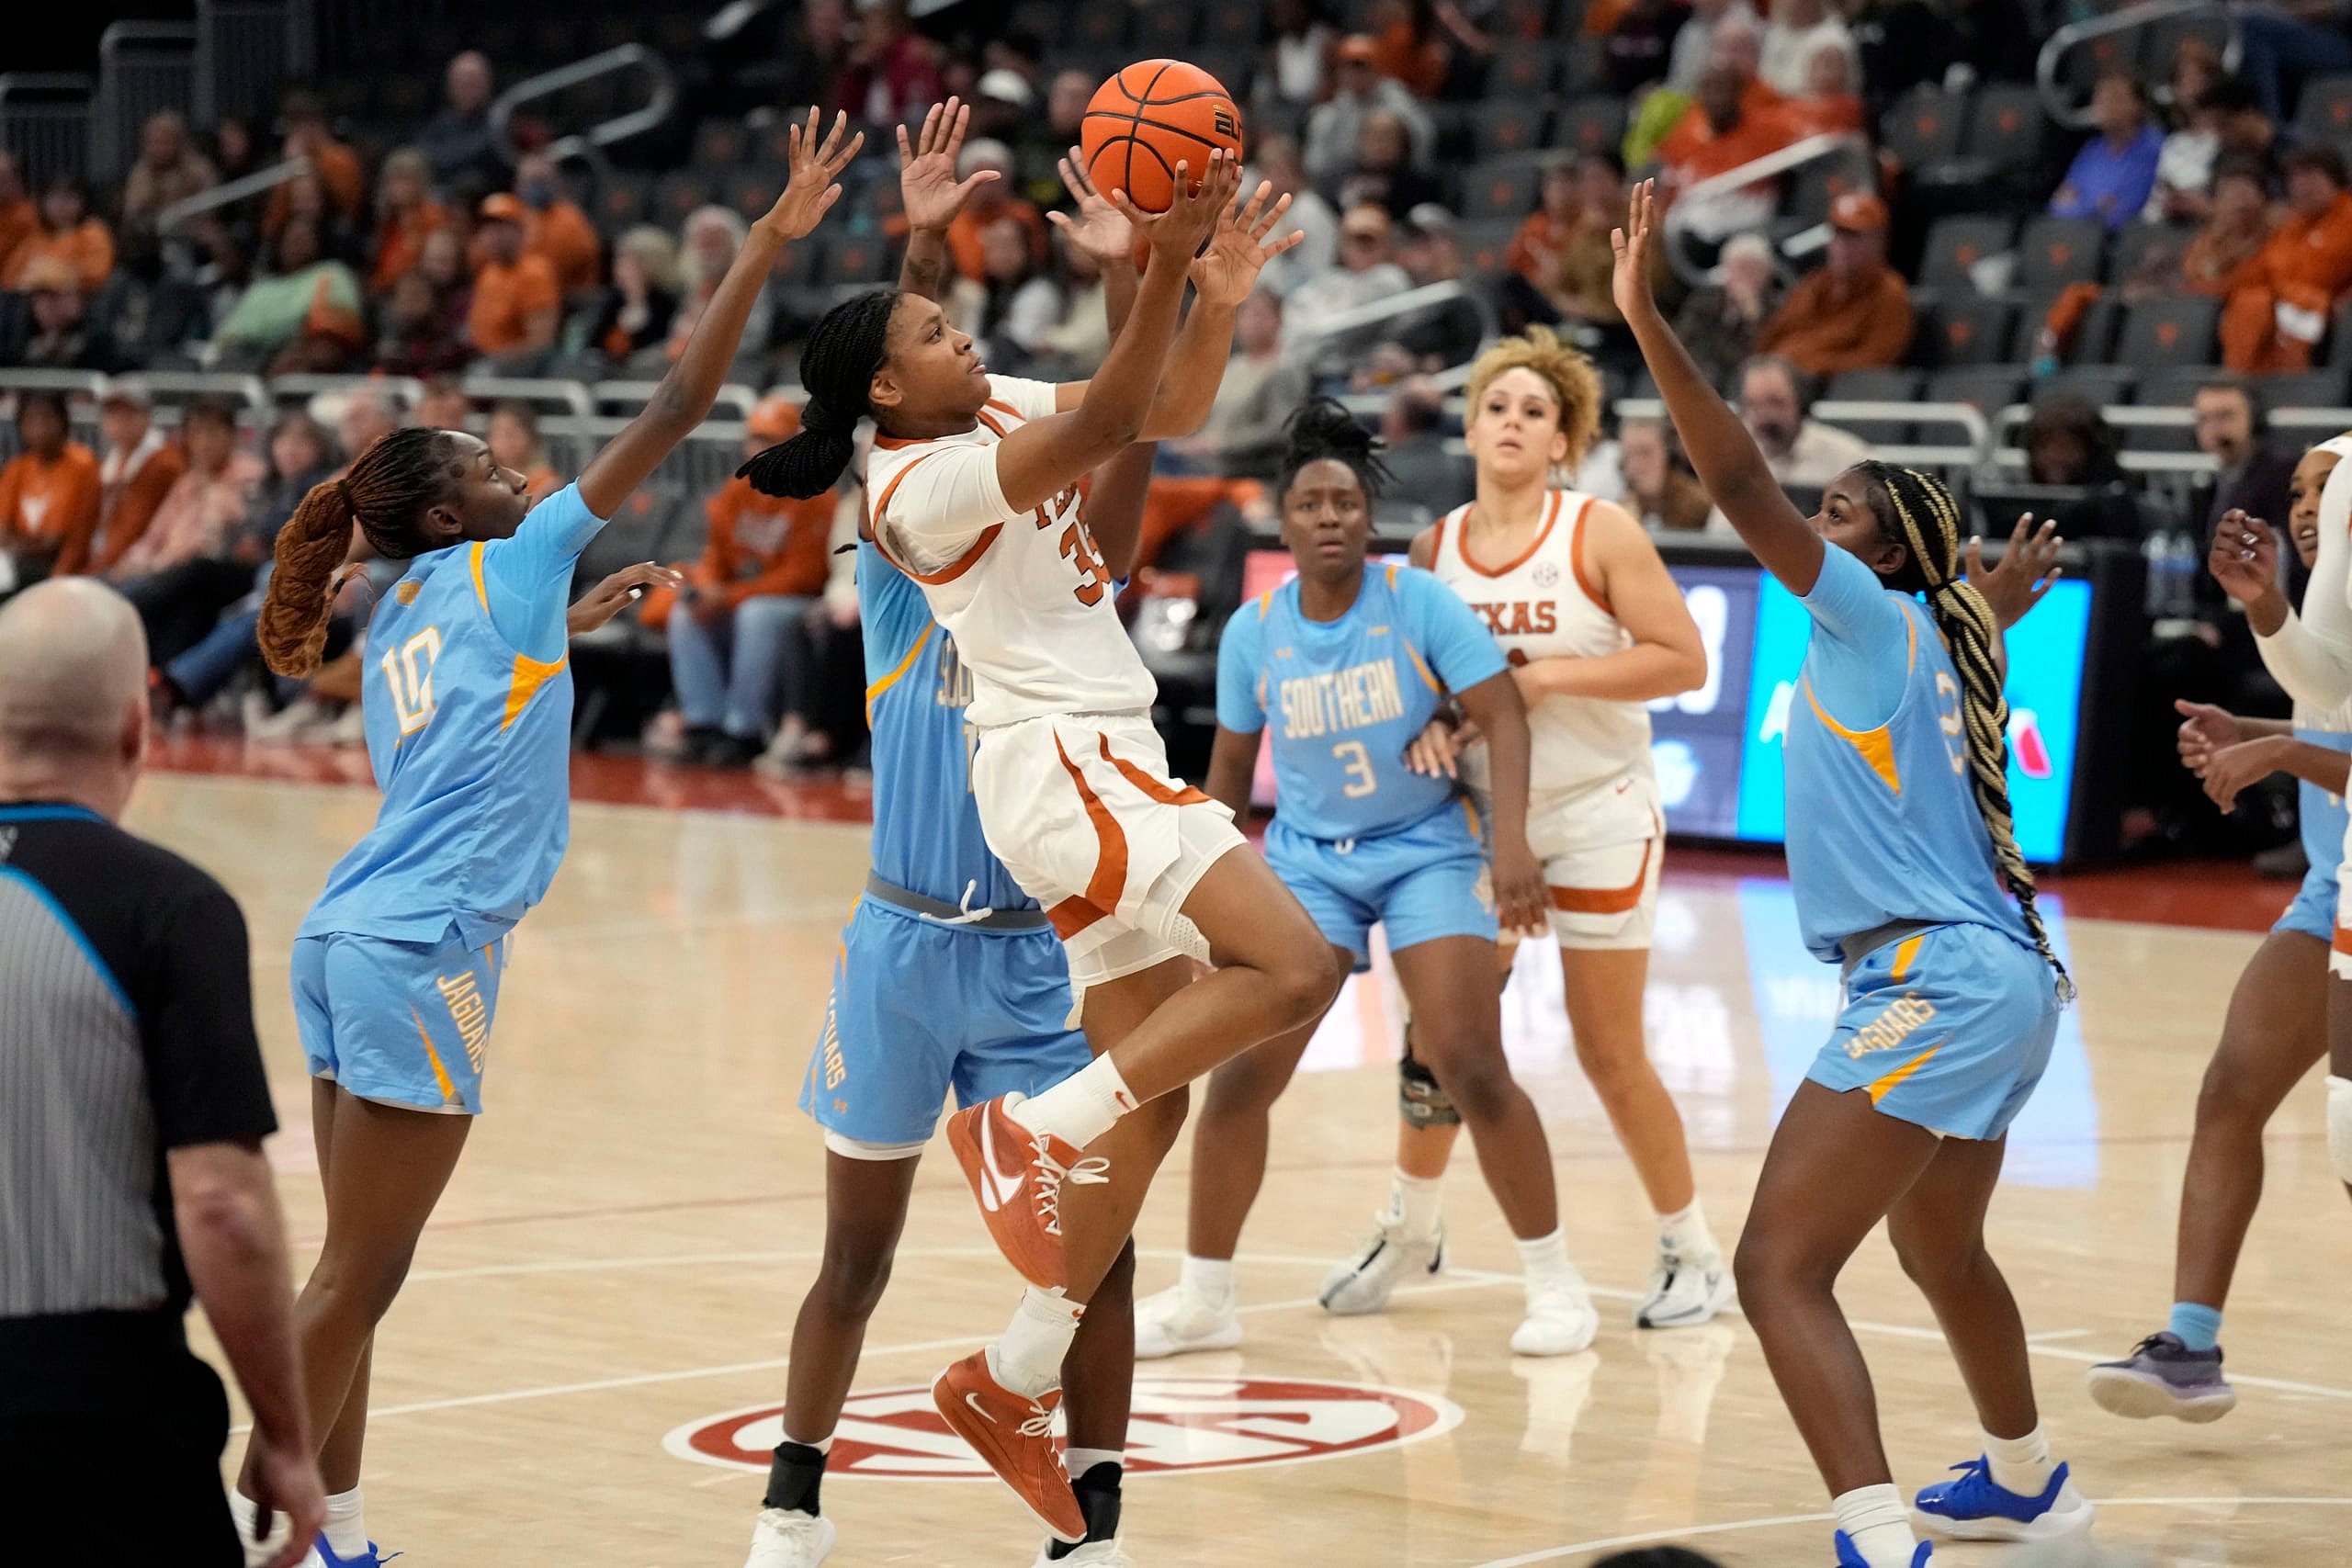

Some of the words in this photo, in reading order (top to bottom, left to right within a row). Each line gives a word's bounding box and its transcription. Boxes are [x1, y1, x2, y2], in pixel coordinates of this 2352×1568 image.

[1470, 601, 1556, 636] XAS
[381, 625, 442, 736] 10
[1281, 658, 1405, 739] SOUTHERN
[1333, 740, 1377, 799] 3
[436, 970, 487, 1075] JAGUARS
